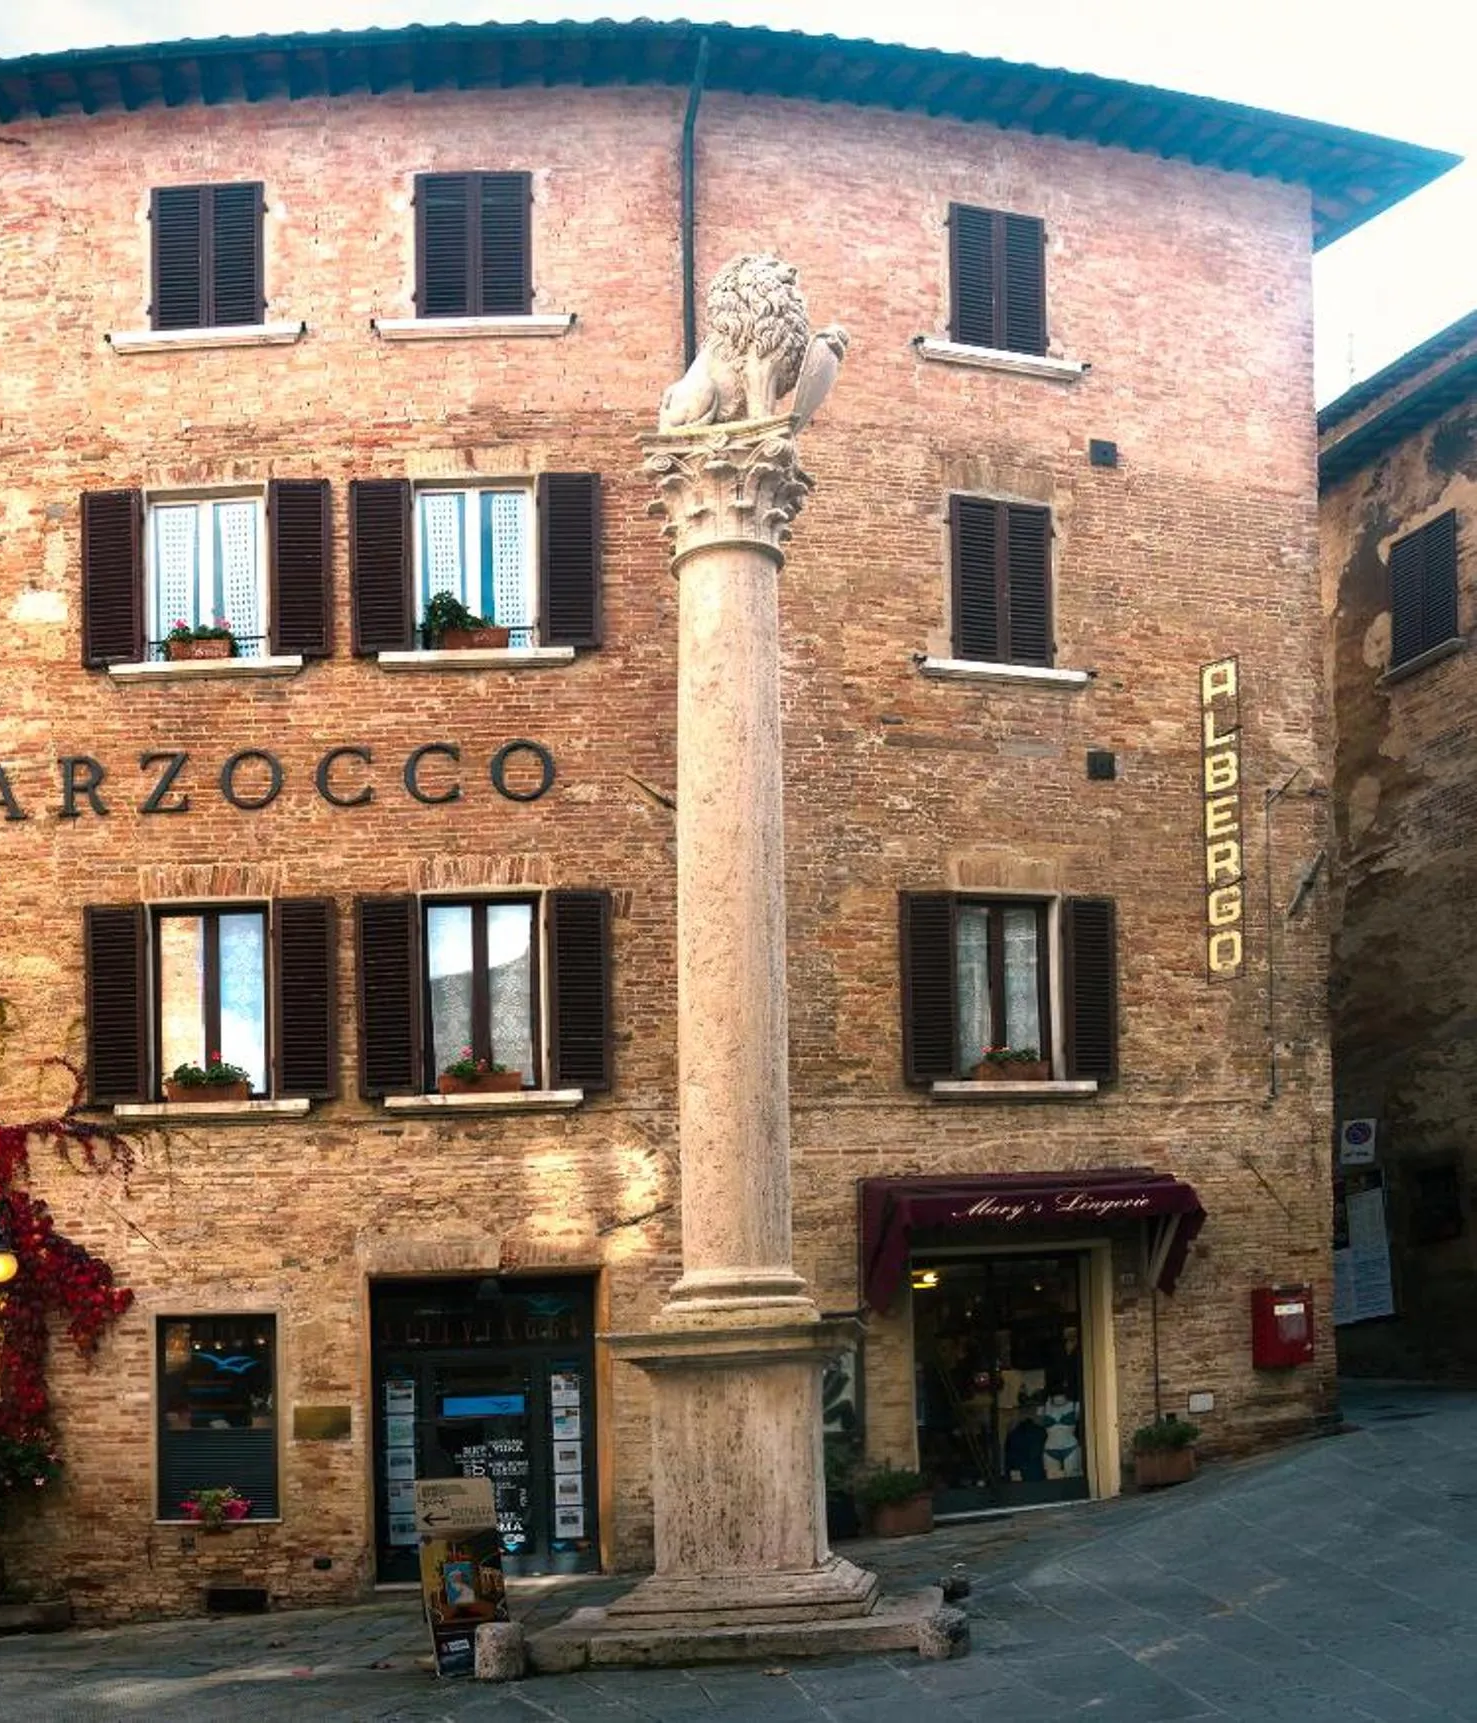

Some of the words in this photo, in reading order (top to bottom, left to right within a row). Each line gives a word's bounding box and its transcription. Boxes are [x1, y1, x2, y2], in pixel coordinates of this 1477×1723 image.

[1202, 661, 1242, 973] ALBERGO
[951, 1196, 1043, 1221] Mary's
[1055, 1192, 1149, 1216] Lingerie
